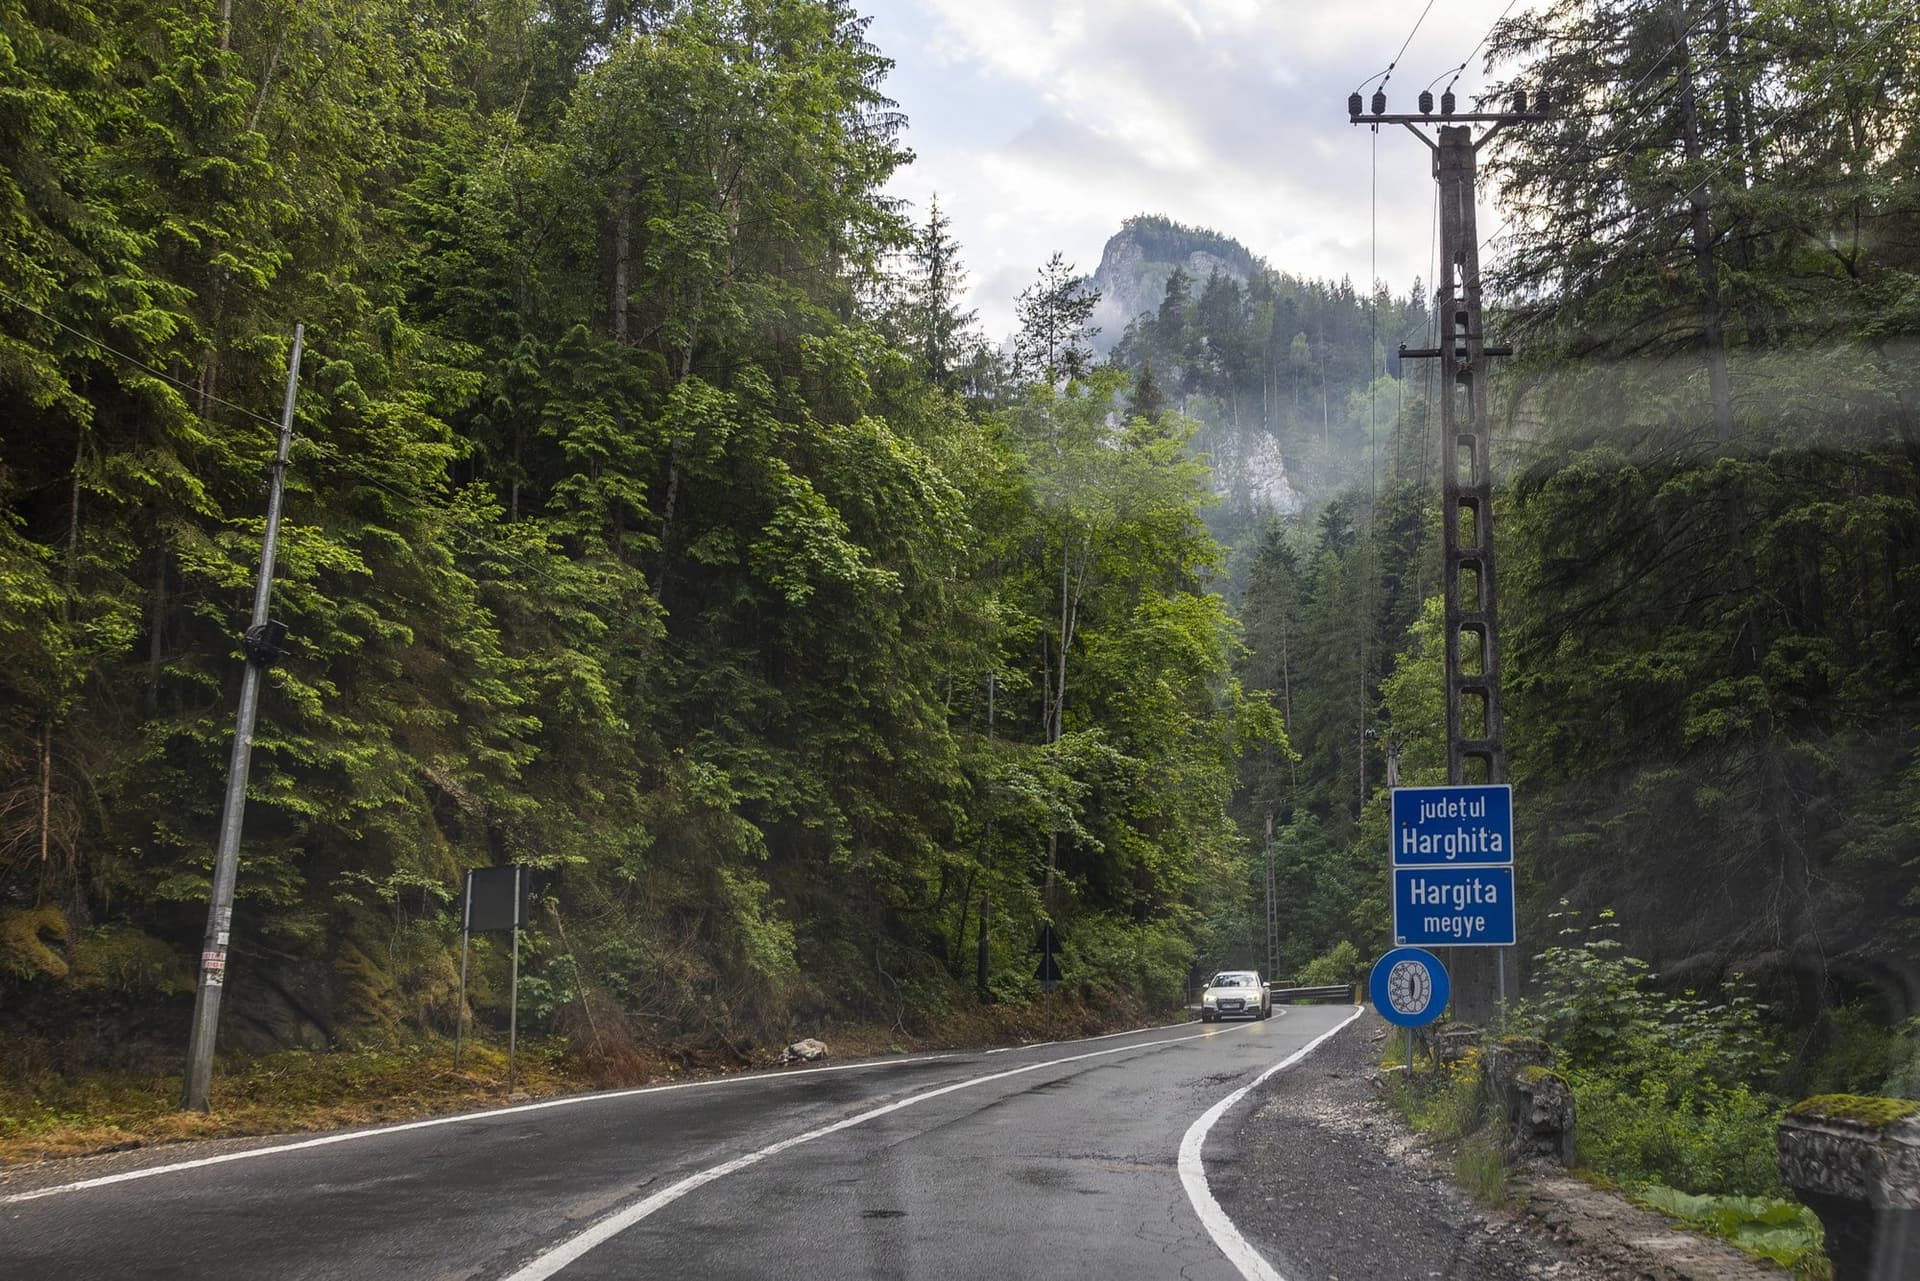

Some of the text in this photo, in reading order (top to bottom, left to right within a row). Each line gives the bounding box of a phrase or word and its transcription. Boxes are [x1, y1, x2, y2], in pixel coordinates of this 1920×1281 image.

[1403, 827, 1502, 859] Harghita
[1411, 878, 1497, 910] Hargita
[1424, 915, 1485, 937] megye
